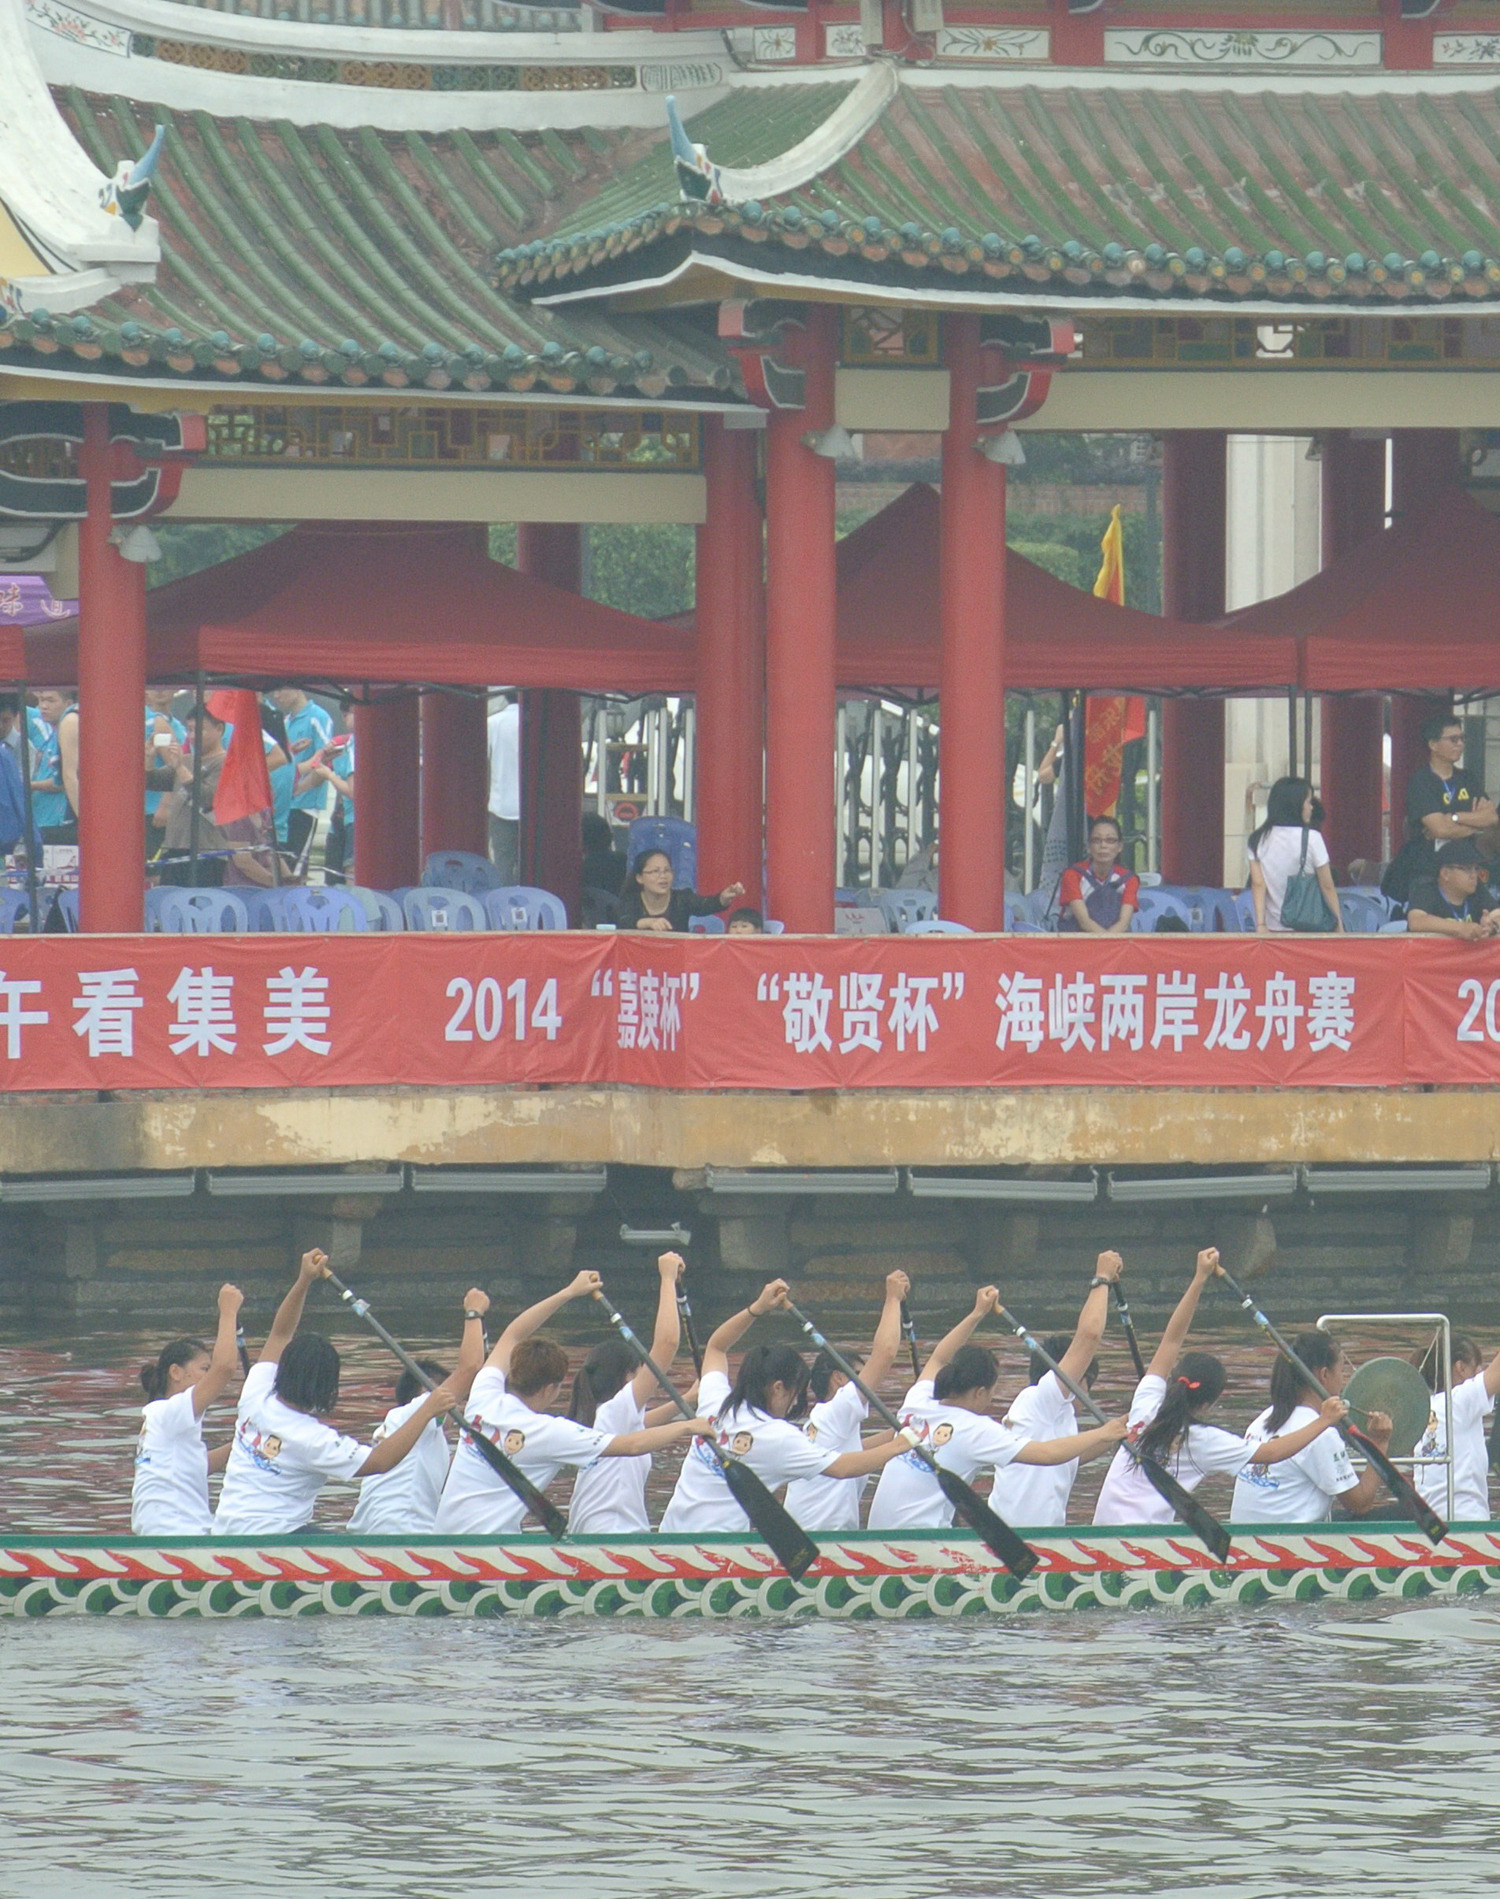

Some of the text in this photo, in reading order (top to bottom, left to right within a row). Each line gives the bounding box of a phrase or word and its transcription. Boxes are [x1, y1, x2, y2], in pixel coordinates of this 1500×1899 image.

[445, 977, 563, 1042] 2014
[995, 970, 1355, 1053] 海峡两岸龙舟赛
